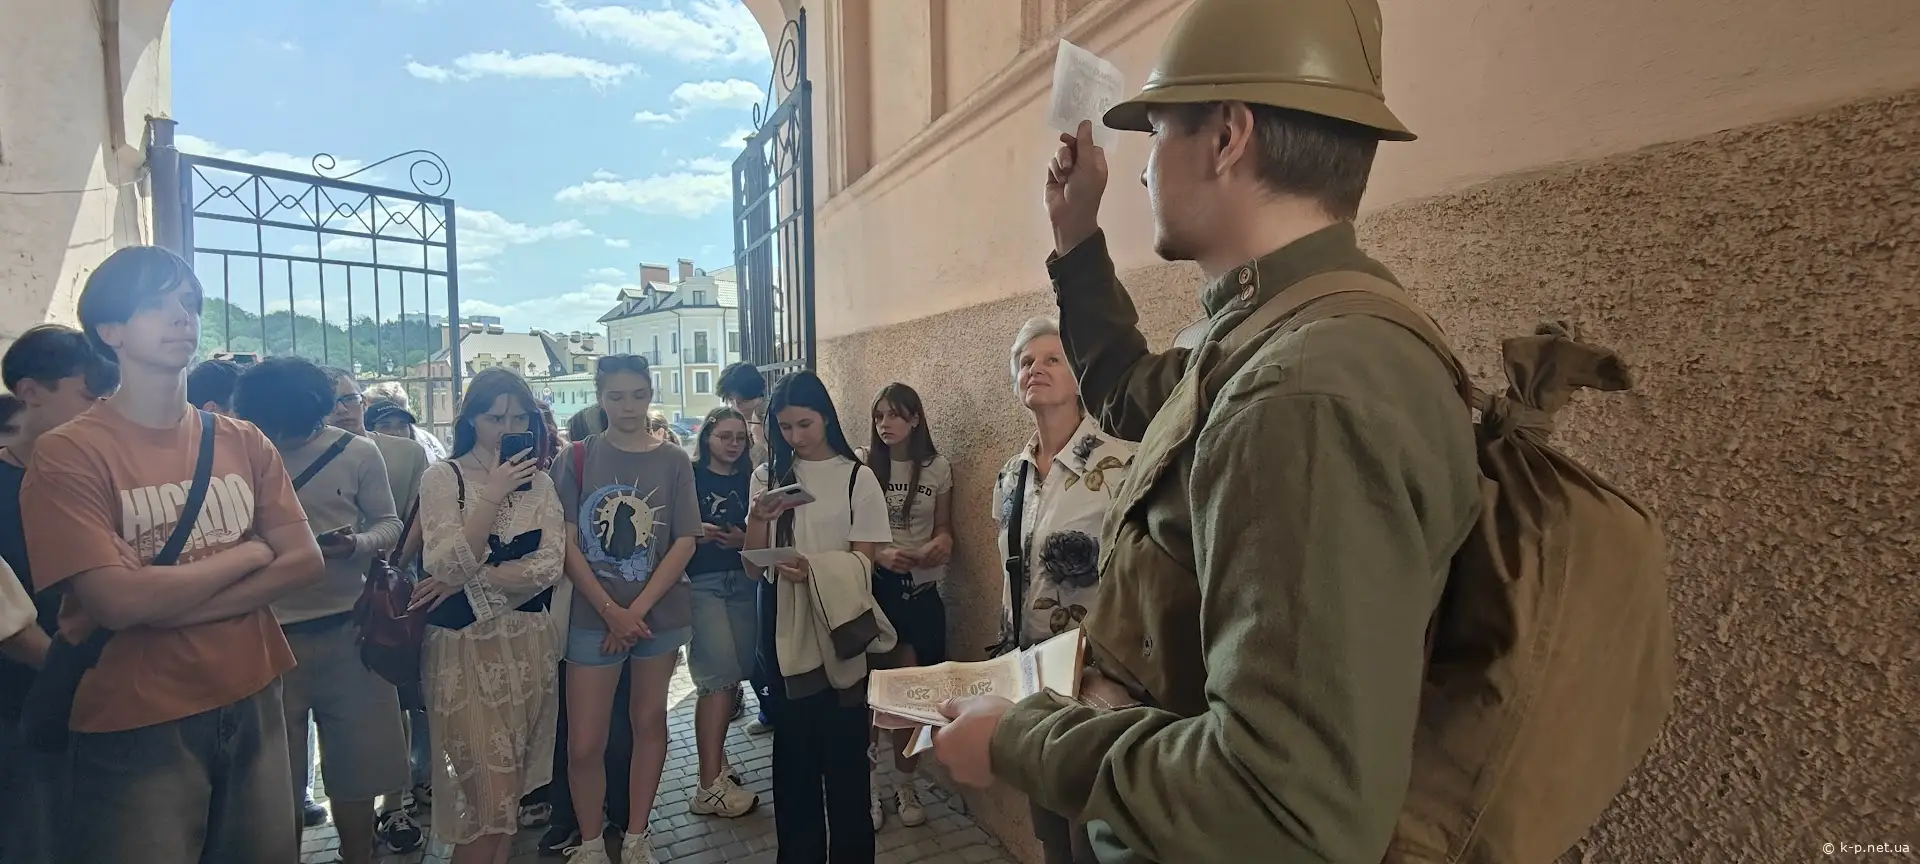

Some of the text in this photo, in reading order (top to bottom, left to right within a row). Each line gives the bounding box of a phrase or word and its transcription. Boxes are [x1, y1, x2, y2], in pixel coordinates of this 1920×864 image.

[888, 483, 933, 497] QUIED
[906, 688, 931, 700] 250
[969, 680, 993, 696] 250
